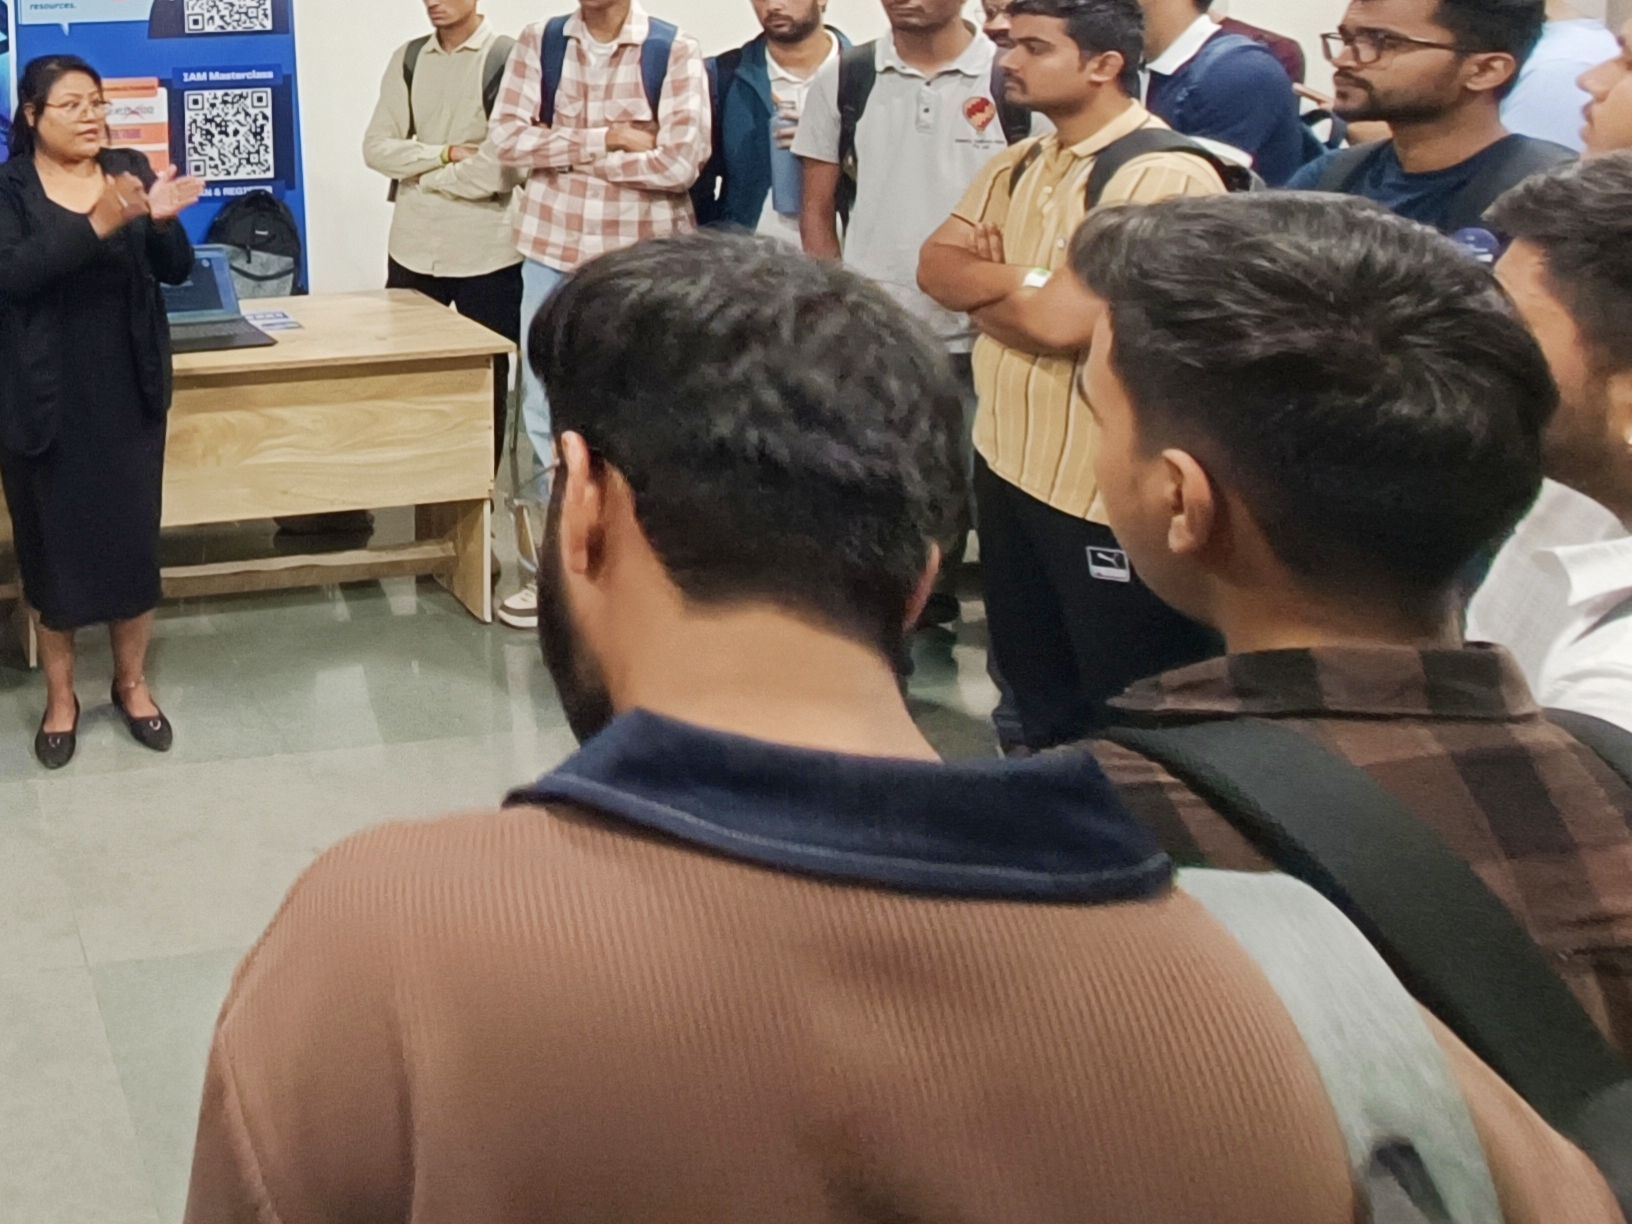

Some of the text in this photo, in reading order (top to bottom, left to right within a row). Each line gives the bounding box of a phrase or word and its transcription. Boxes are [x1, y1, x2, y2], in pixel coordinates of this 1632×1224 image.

[30, 2, 76, 10] resources.
[183, 70, 274, 82] IAM Masterclass
